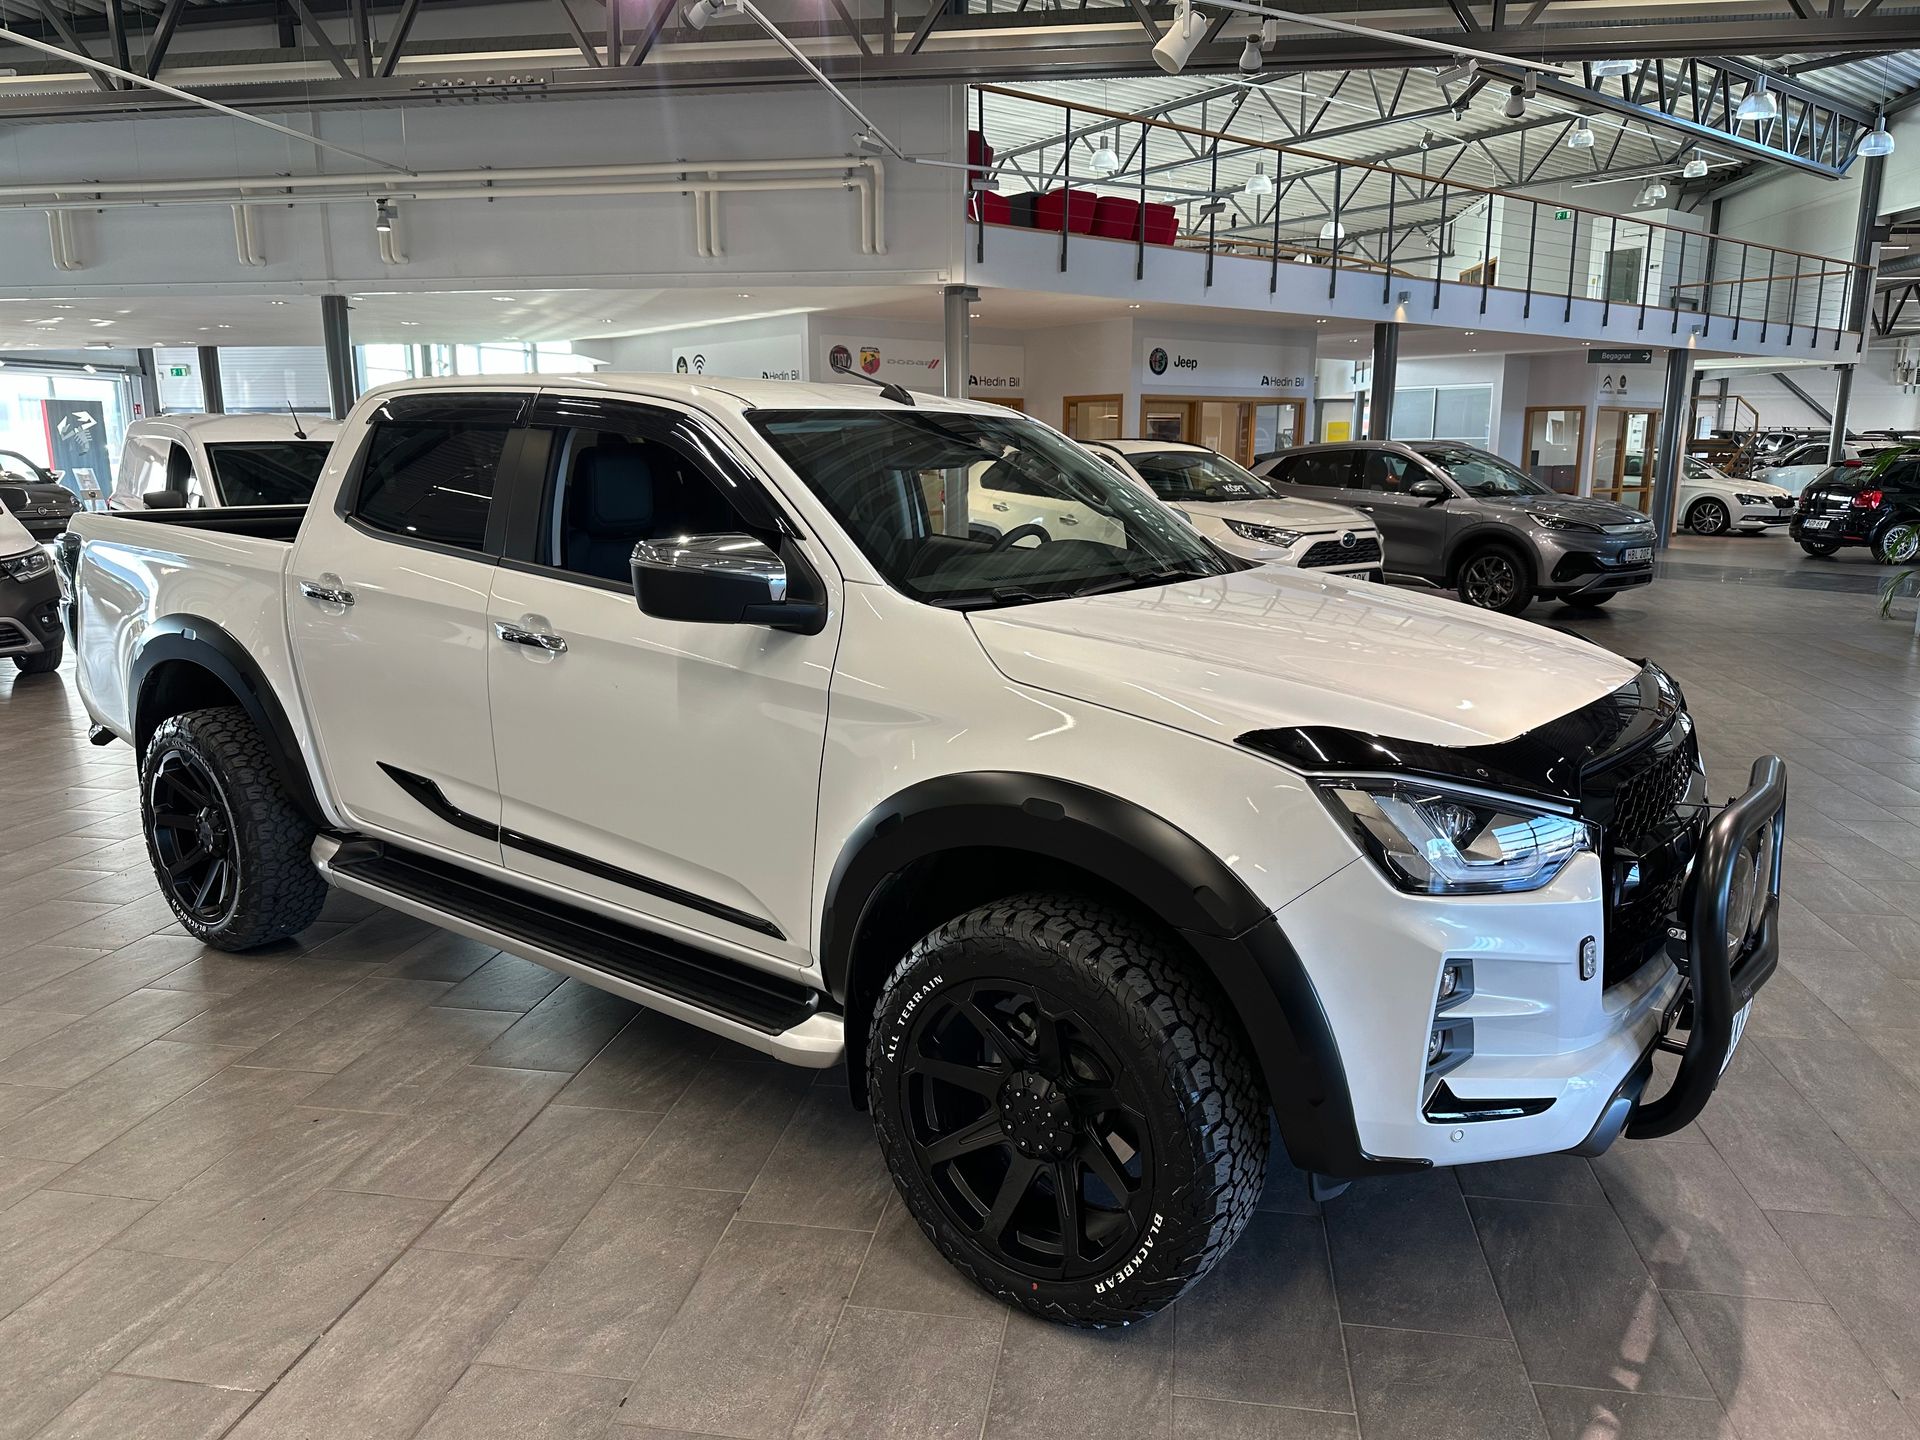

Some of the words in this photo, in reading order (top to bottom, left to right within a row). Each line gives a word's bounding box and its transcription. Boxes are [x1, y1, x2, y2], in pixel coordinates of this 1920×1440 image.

[1601, 352, 1632, 360] Begagnat
[1173, 355, 1198, 371] Jeep
[979, 376, 1006, 387] Hedin
[1009, 377, 1020, 387] Bil
[1270, 376, 1292, 387] Hedin
[1295, 377, 1305, 387] Bil
[887, 1035, 900, 1063] ALL
[897, 975, 944, 1026] TERRAIN
[1094, 1212, 1164, 1294] BLACKBEAR
